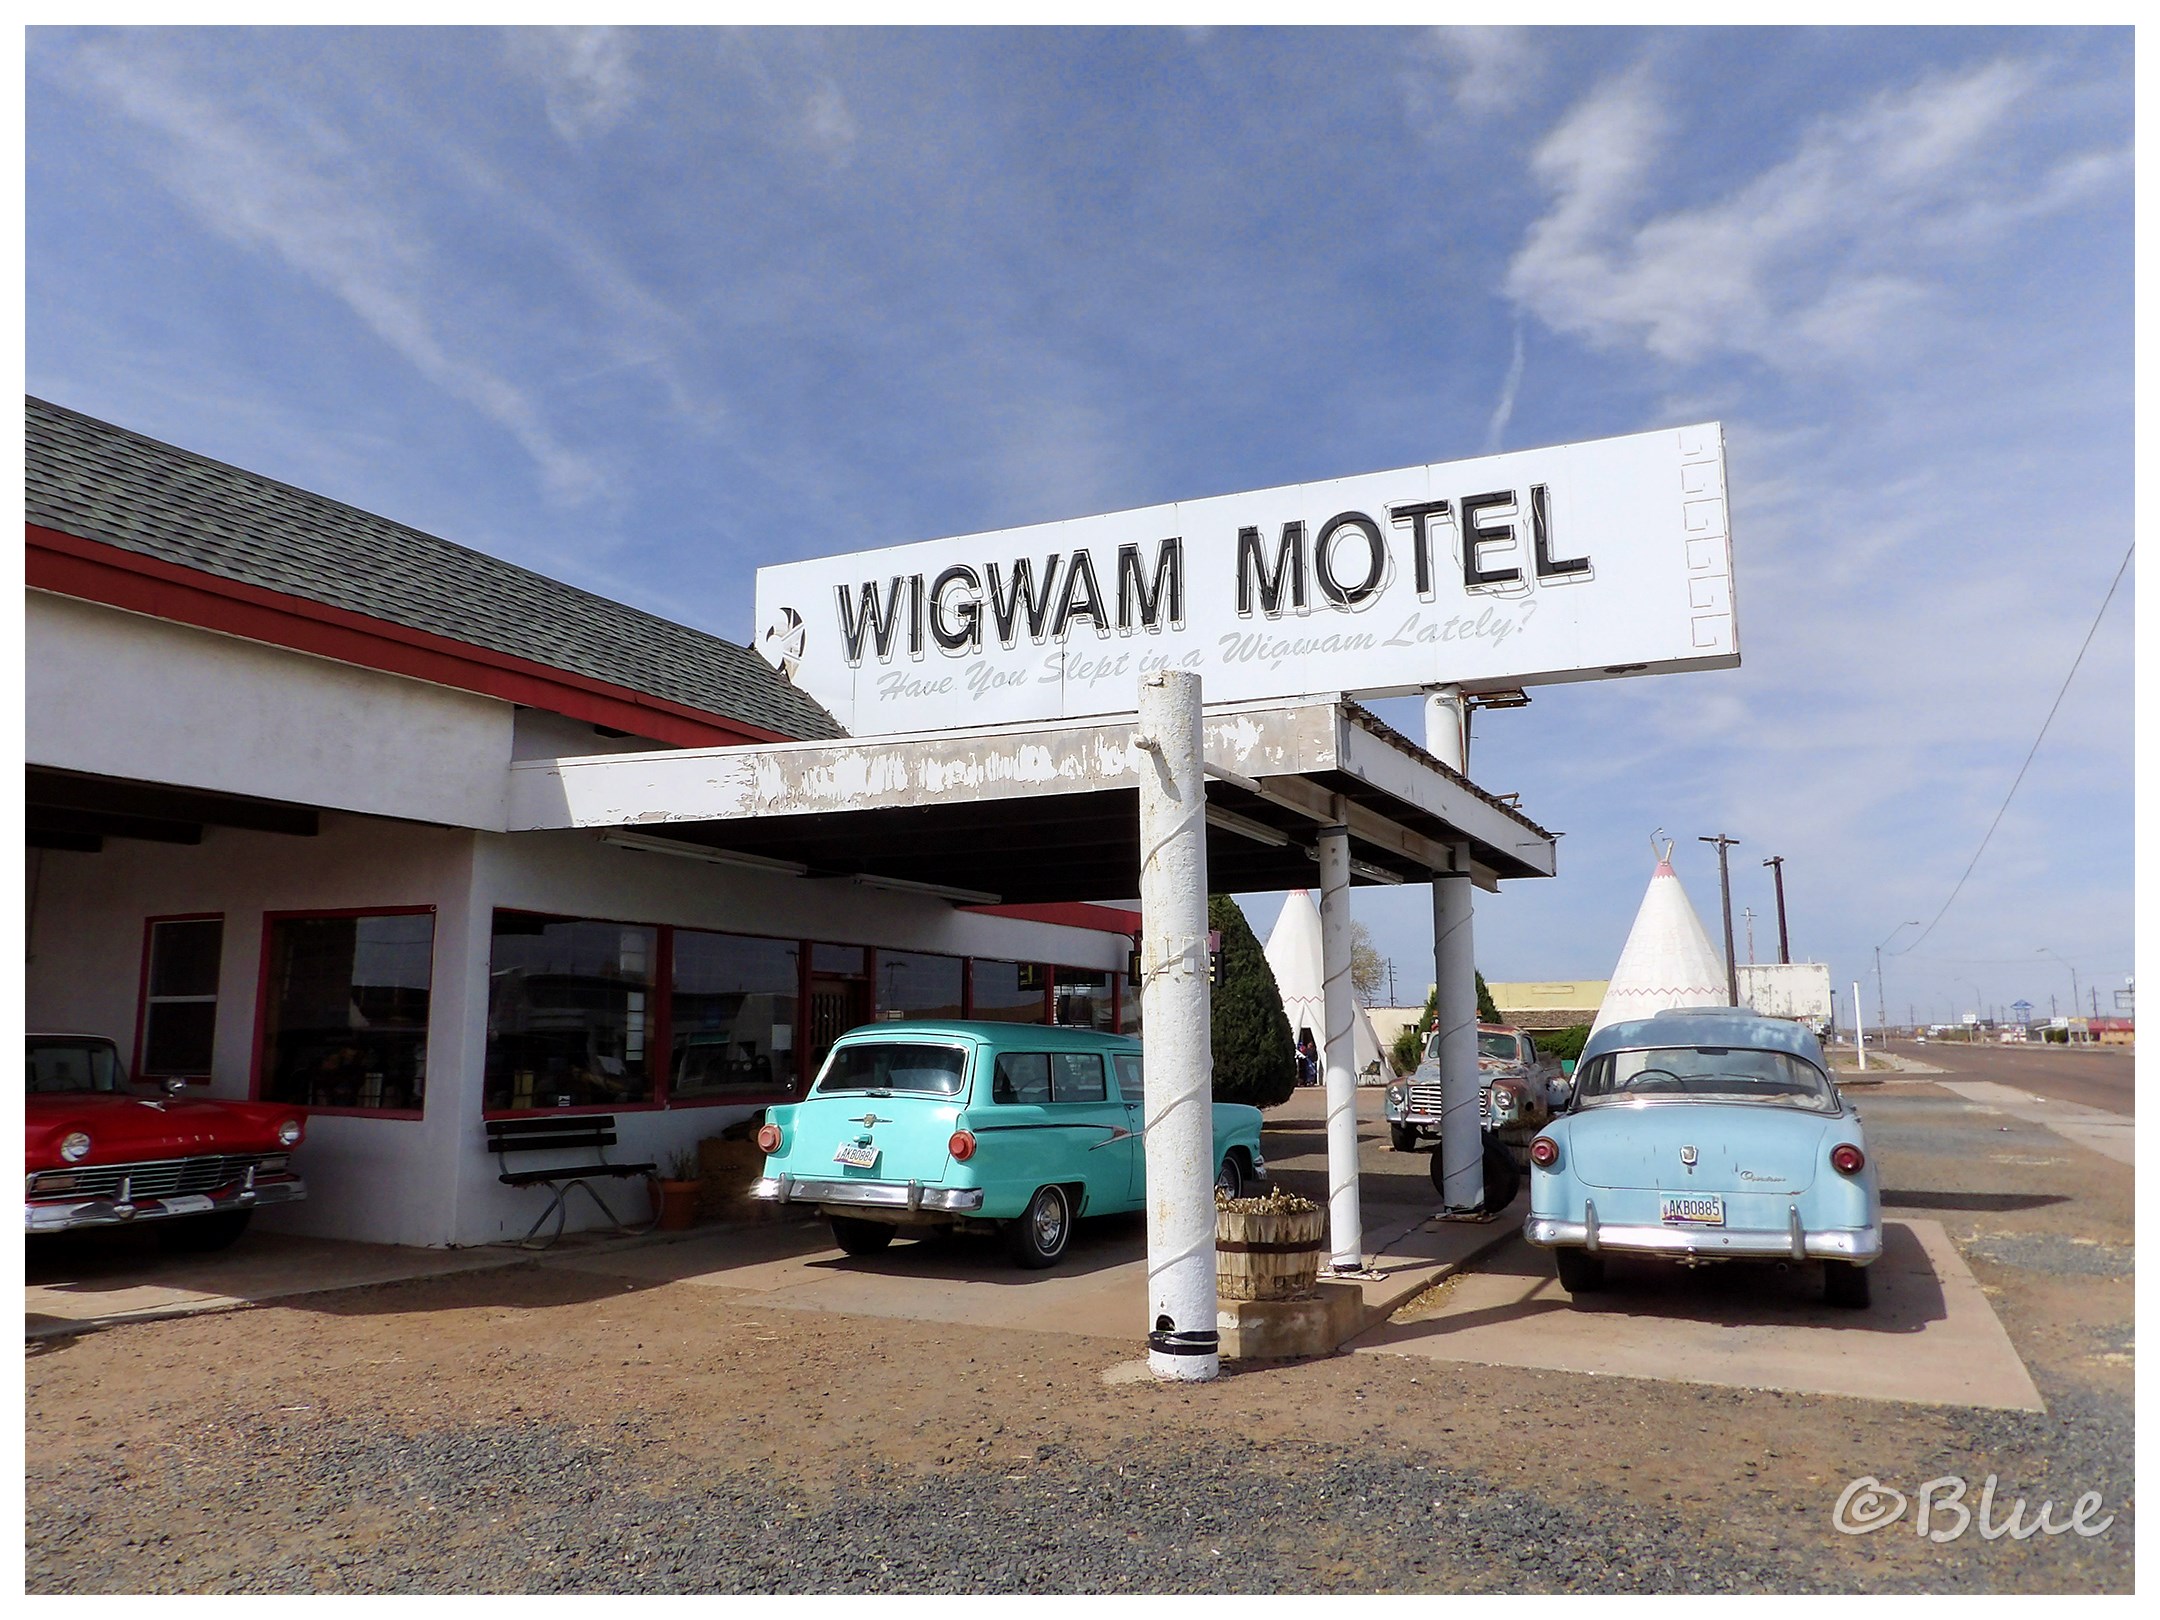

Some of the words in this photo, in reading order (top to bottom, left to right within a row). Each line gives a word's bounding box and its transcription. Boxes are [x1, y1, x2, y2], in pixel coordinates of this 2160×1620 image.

[833, 536, 1186, 668] WIGWAM
[1235, 483, 1595, 619] MOTEL
[877, 670, 954, 702] Have
[965, 660, 1028, 701] You
[1038, 651, 1131, 689] Slept
[1138, 649, 1171, 673] in
[1181, 648, 1206, 668] a
[1218, 631, 1378, 672] Wigwam
[1382, 600, 1538, 649] Lately?
[1669, 1199, 1720, 1216] AKB0885
